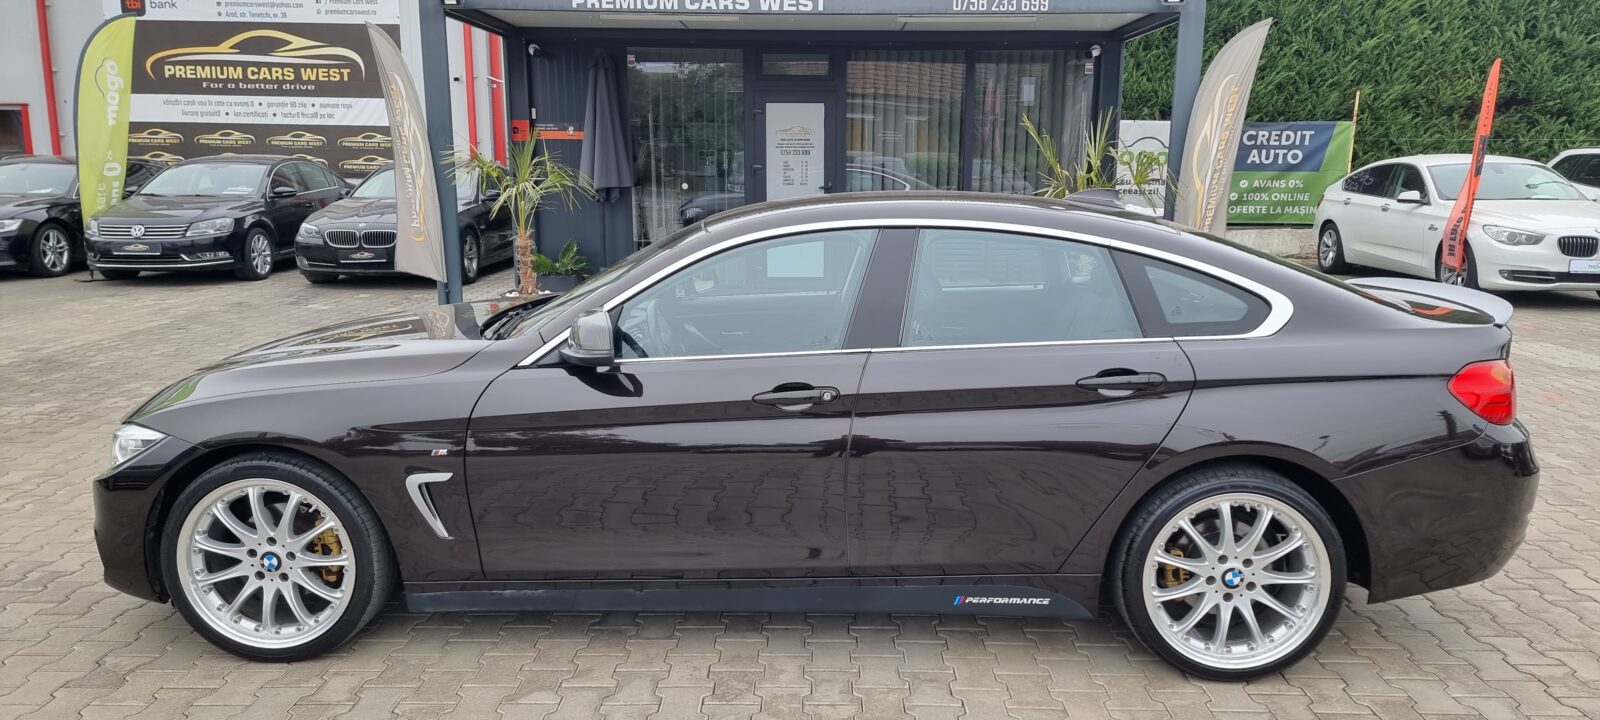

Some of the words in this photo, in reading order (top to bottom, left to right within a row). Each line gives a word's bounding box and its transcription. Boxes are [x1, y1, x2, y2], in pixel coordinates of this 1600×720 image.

[150, 0, 178, 9] bank
[685, 0, 750, 11] CARS
[760, 0, 825, 11] WEST
[164, 65, 243, 79] PREMIUM
[247, 67, 295, 81] CARS
[301, 68, 351, 82] WEST
[239, 82, 279, 90] better
[282, 83, 316, 91] drive
[106, 58, 124, 127] mogo
[1242, 130, 1315, 146] CREDIT
[1246, 149, 1303, 164] AUTO
[1252, 179, 1286, 188] AVANS
[1288, 179, 1304, 188] 0%
[1242, 192, 1269, 201] 100%
[1271, 192, 1311, 201] ONLINE
[1228, 205, 1268, 214] OFERTE
[1284, 206, 1318, 216] MAȘIN
[964, 596, 1051, 605] PERFORMANCE
